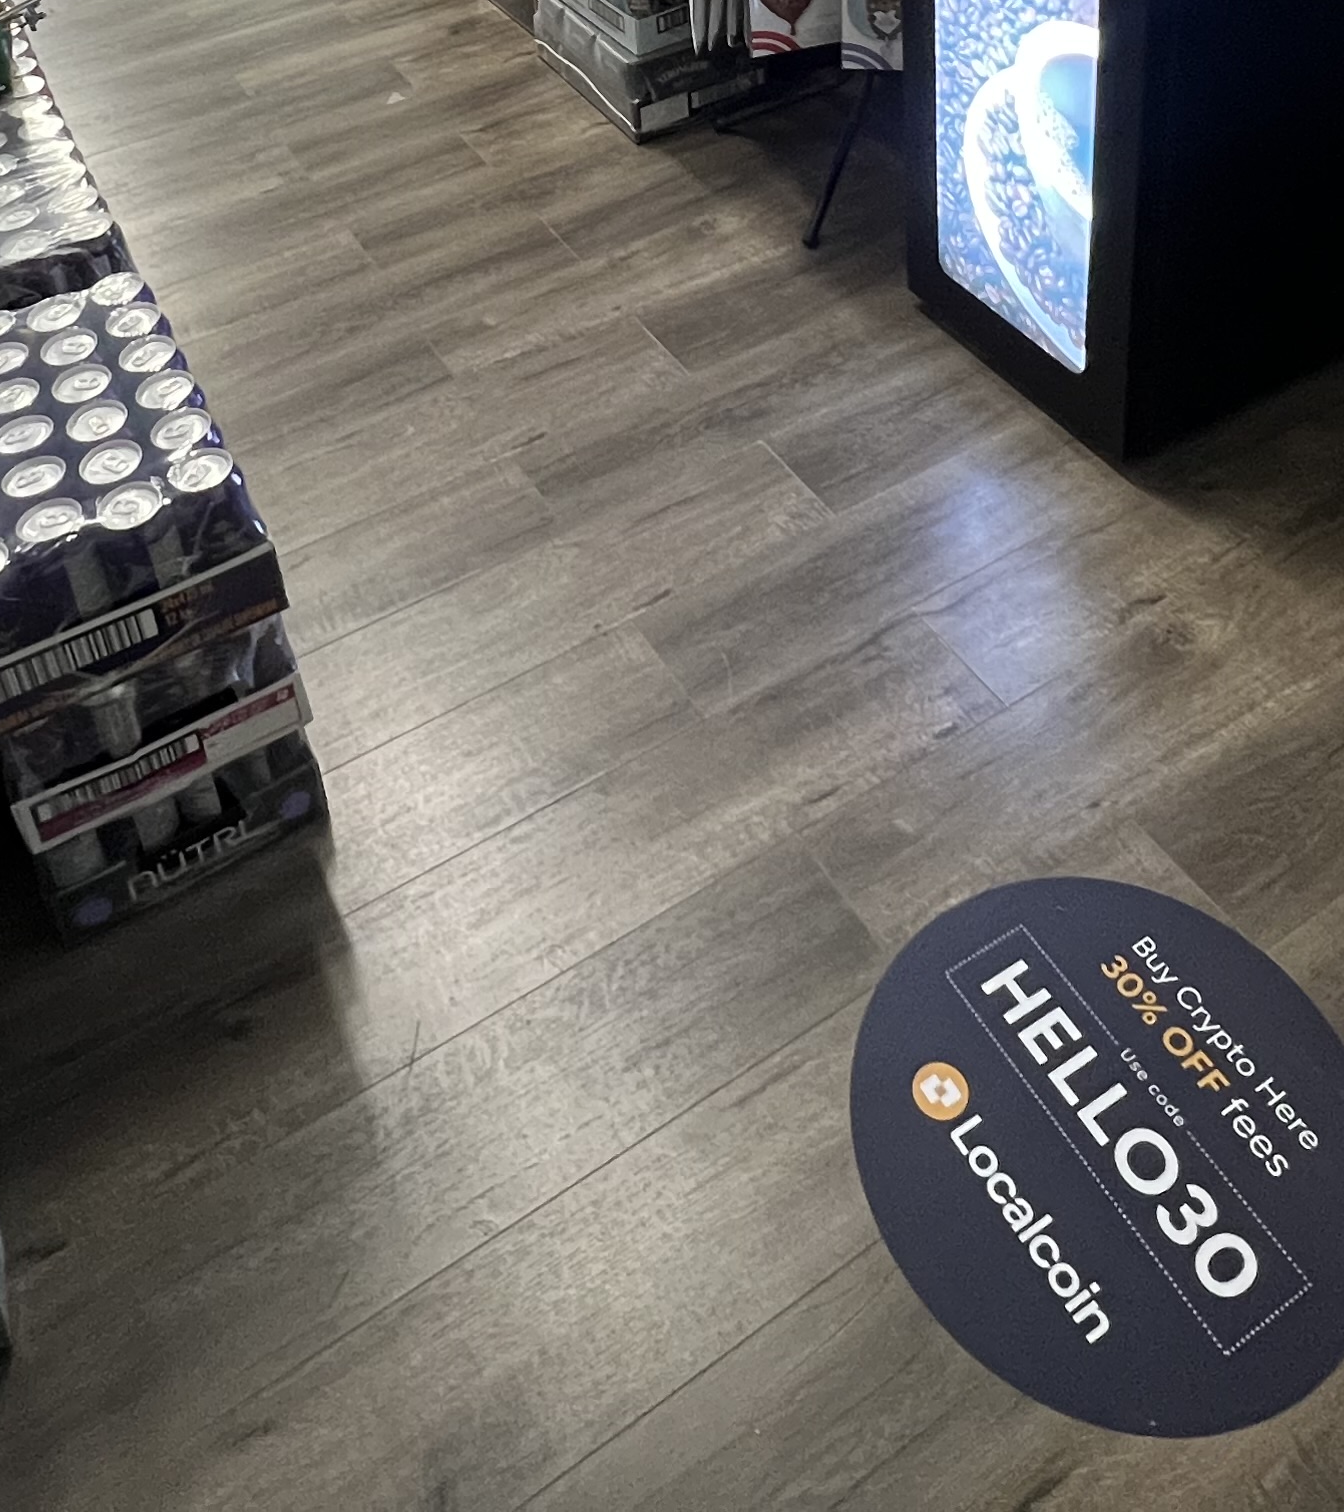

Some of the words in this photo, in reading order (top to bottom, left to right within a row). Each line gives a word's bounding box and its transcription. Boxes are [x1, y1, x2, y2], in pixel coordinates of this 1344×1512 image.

[980, 959, 1258, 1298] HELLO30
[1101, 955, 1168, 1026] 30%
[1162, 1026, 1231, 1093] OFF
[1220, 1097, 1290, 1177] fees
[1120, 1047, 1150, 1083] Use
[1147, 1082, 1186, 1129] code
[1131, 935, 1179, 985] Buy
[1176, 985, 1257, 1079] Crypto
[1252, 1076, 1320, 1150] Here
[950, 1114, 1112, 1344] Localcoin
